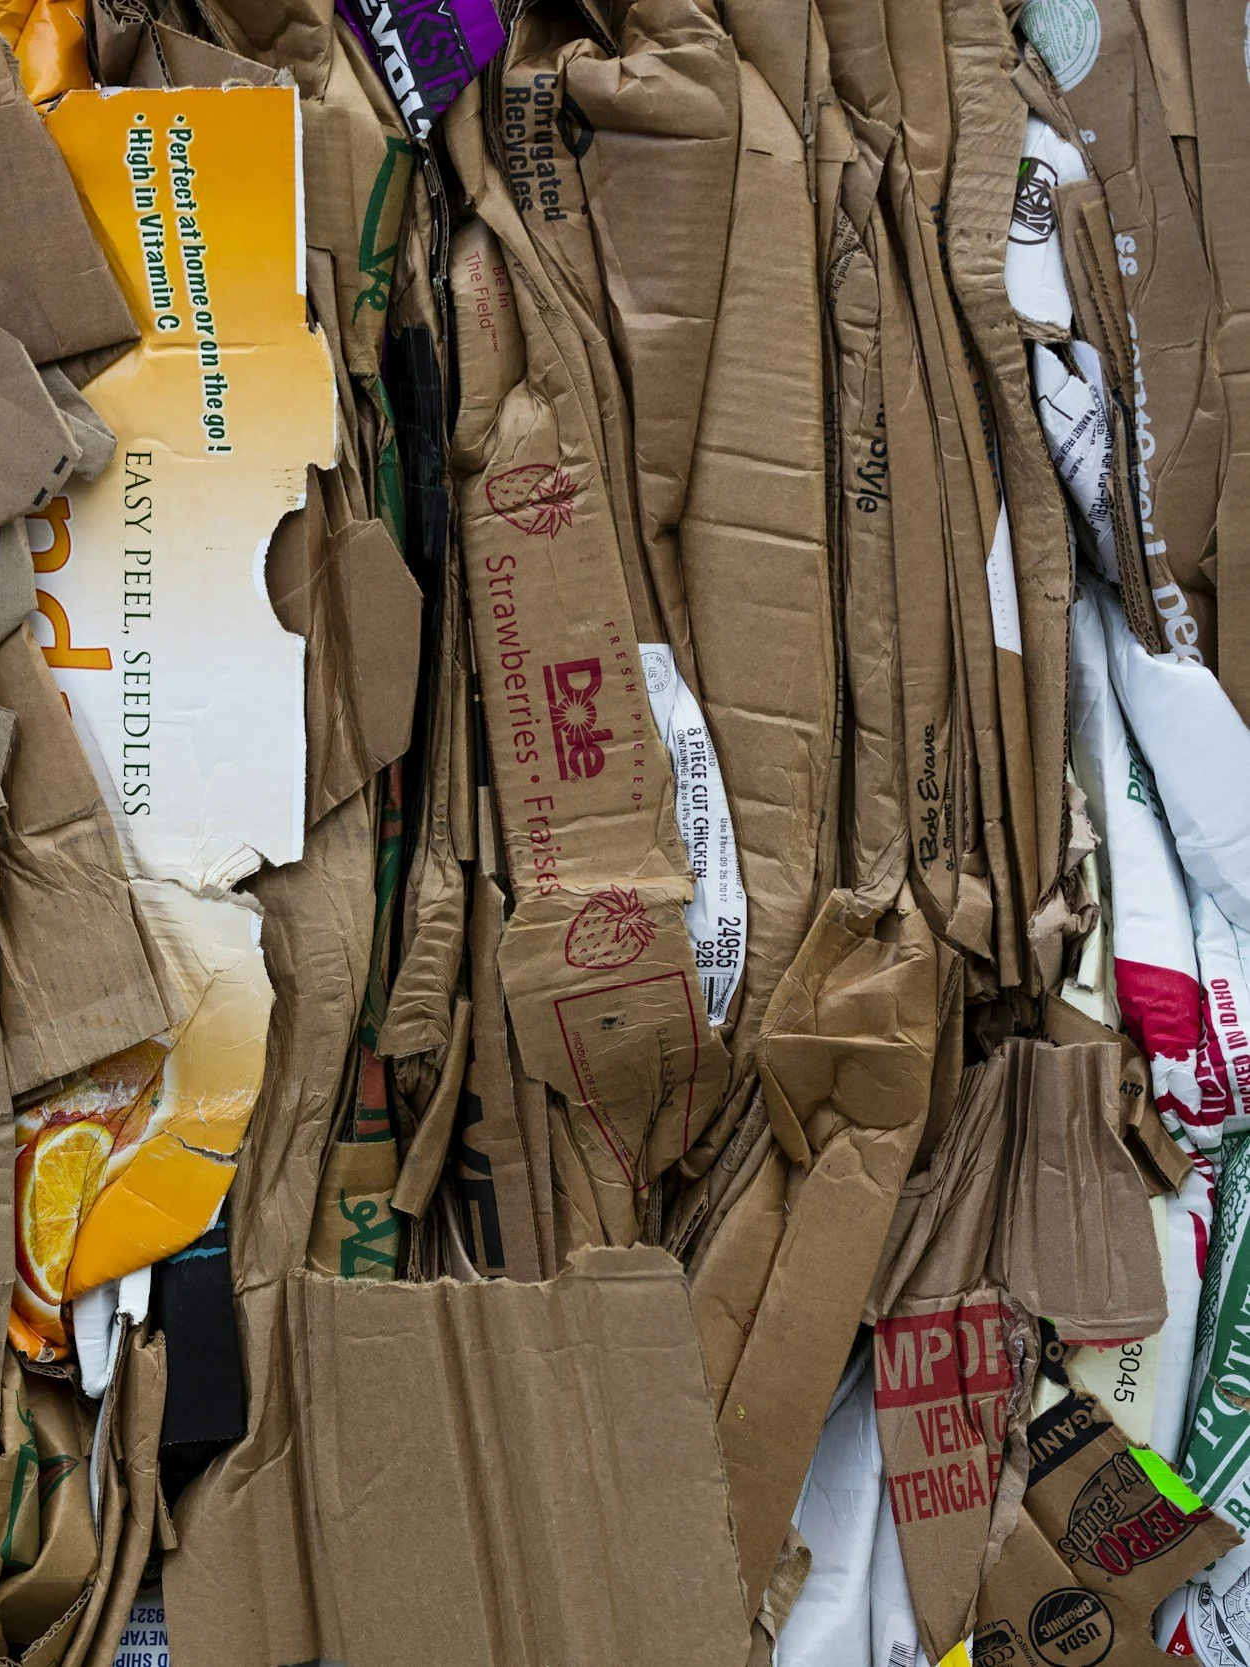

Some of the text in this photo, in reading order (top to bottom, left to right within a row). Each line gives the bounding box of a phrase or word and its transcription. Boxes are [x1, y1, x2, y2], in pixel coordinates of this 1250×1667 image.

[167, 126, 197, 214] Perfect
[505, 87, 534, 213] Recycles
[529, 73, 567, 222] Corrugated
[125, 128, 180, 331] High in Vitamin C
[179, 216, 200, 241] at
[835, 215, 851, 239] 2015
[183, 244, 209, 307] home
[464, 250, 482, 282] The
[492, 266, 508, 309] Be In
[198, 310, 214, 336] or
[472, 286, 496, 330] Field
[200, 341, 220, 367] on
[204, 371, 228, 409] the
[1070, 411, 1093, 440] MARKET
[857, 438, 888, 514] Style
[123, 451, 152, 817] EASY PEEL, SEEDLESS
[485, 554, 541, 764] Strawberries
[554, 656, 614, 781] Dole
[603, 620, 645, 801] FRESH PICKED
[680, 780, 688, 791] Up
[687, 728, 710, 879] 8 PIECE CUT CHICKEN
[917, 722, 940, 870] Bob Evans
[681, 802, 691, 821] 14%
[522, 795, 562, 898] Fraises
[719, 818, 729, 903] Use Thru 09 26 2017
[695, 940, 714, 968] 928
[716, 916, 741, 968] 24955
[1210, 978, 1240, 1027] IDAHO
[571, 1031, 592, 1074] PRODUCE
[584, 1074, 595, 1086] OF
[1225, 1030, 1248, 1051] IN
[1114, 1343, 1143, 1403] 3045
[1058, 1486, 1126, 1563] Farms
[130, 1608, 165, 1623] 9321
[1039, 1599, 1093, 1638] ORGANIC
[1055, 1622, 1102, 1656] USDA
[113, 1652, 152, 1667] SHIP
